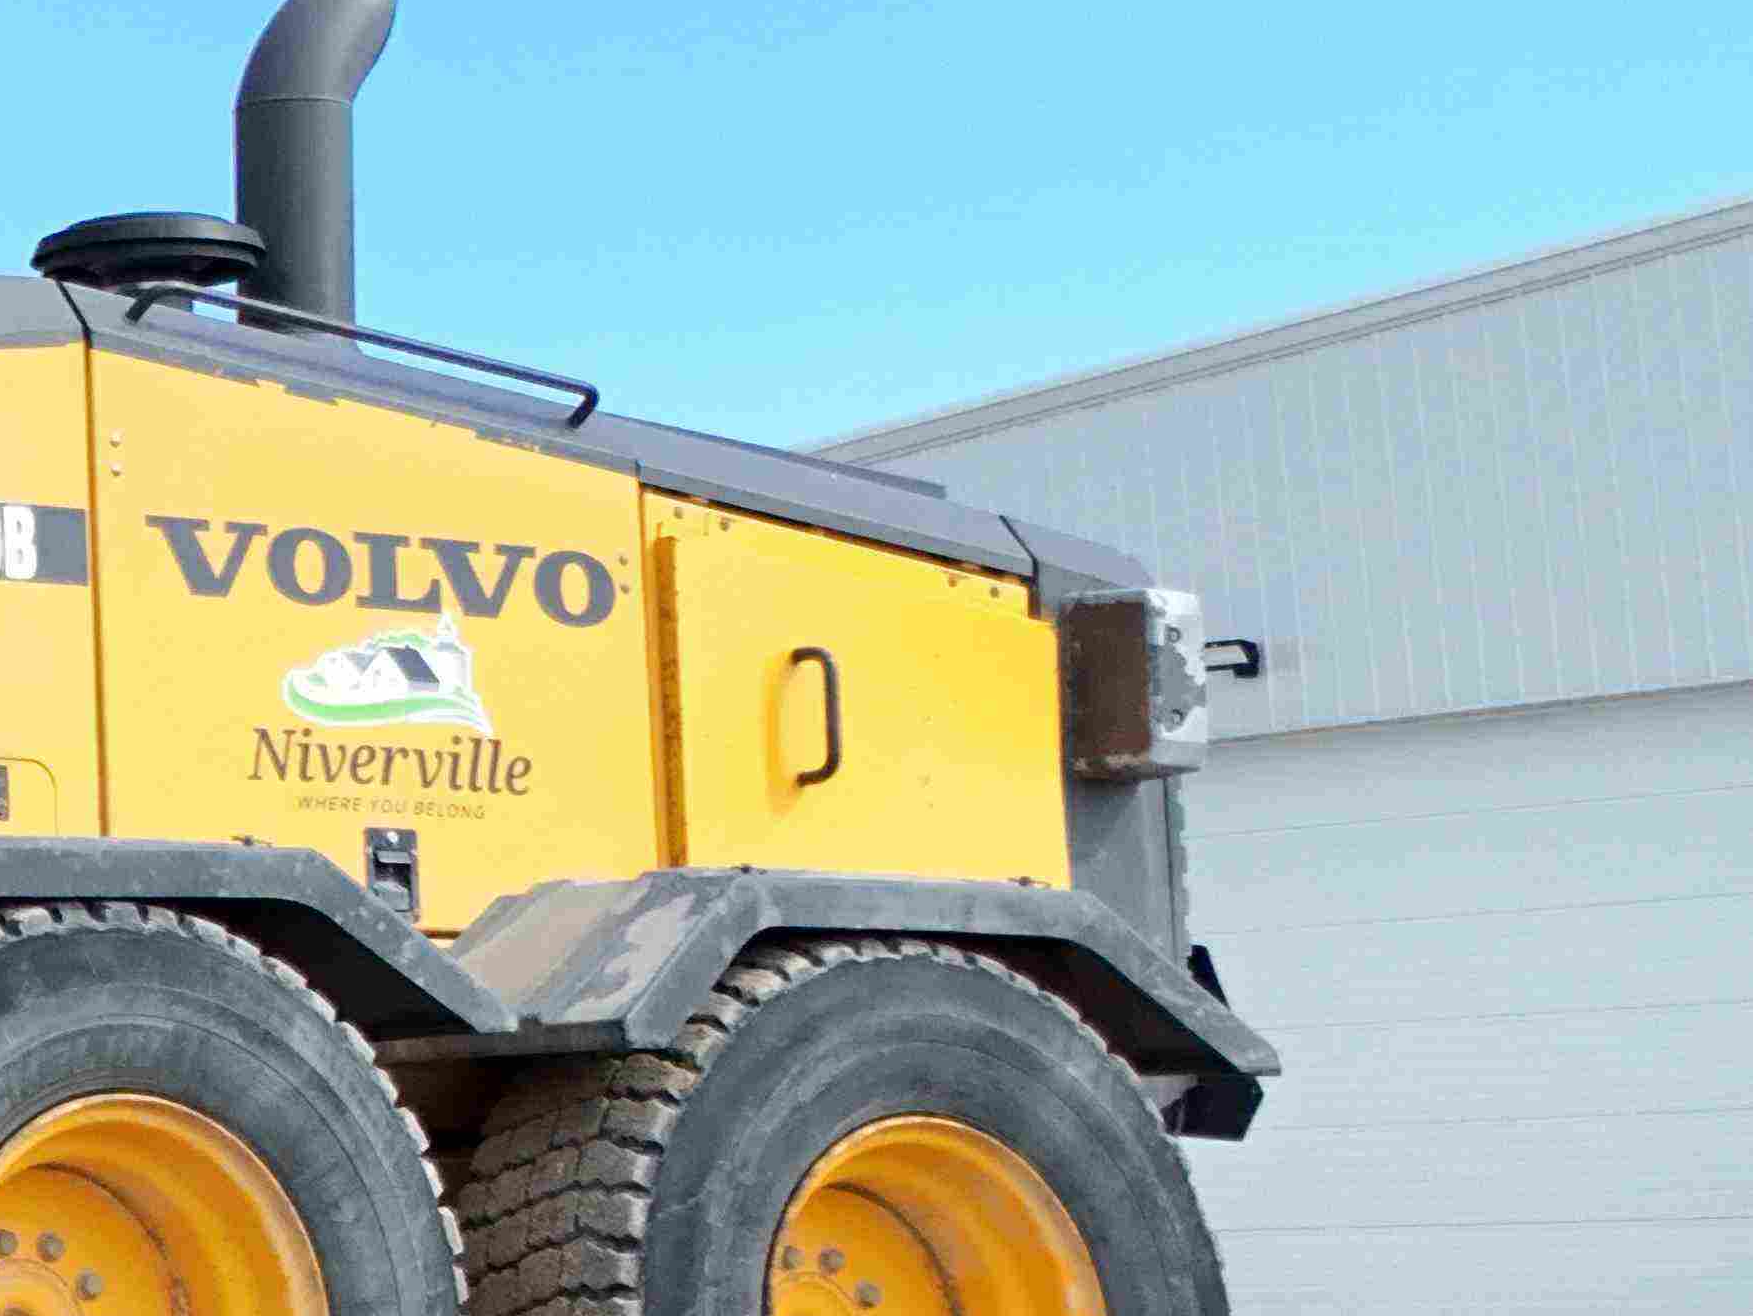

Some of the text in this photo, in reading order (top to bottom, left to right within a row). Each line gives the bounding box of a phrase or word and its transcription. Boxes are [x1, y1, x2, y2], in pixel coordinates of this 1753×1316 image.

[145, 515, 617, 628] VOLVO
[247, 727, 533, 796] Niverville
[297, 796, 486, 820] WHERE YOU BELONG
